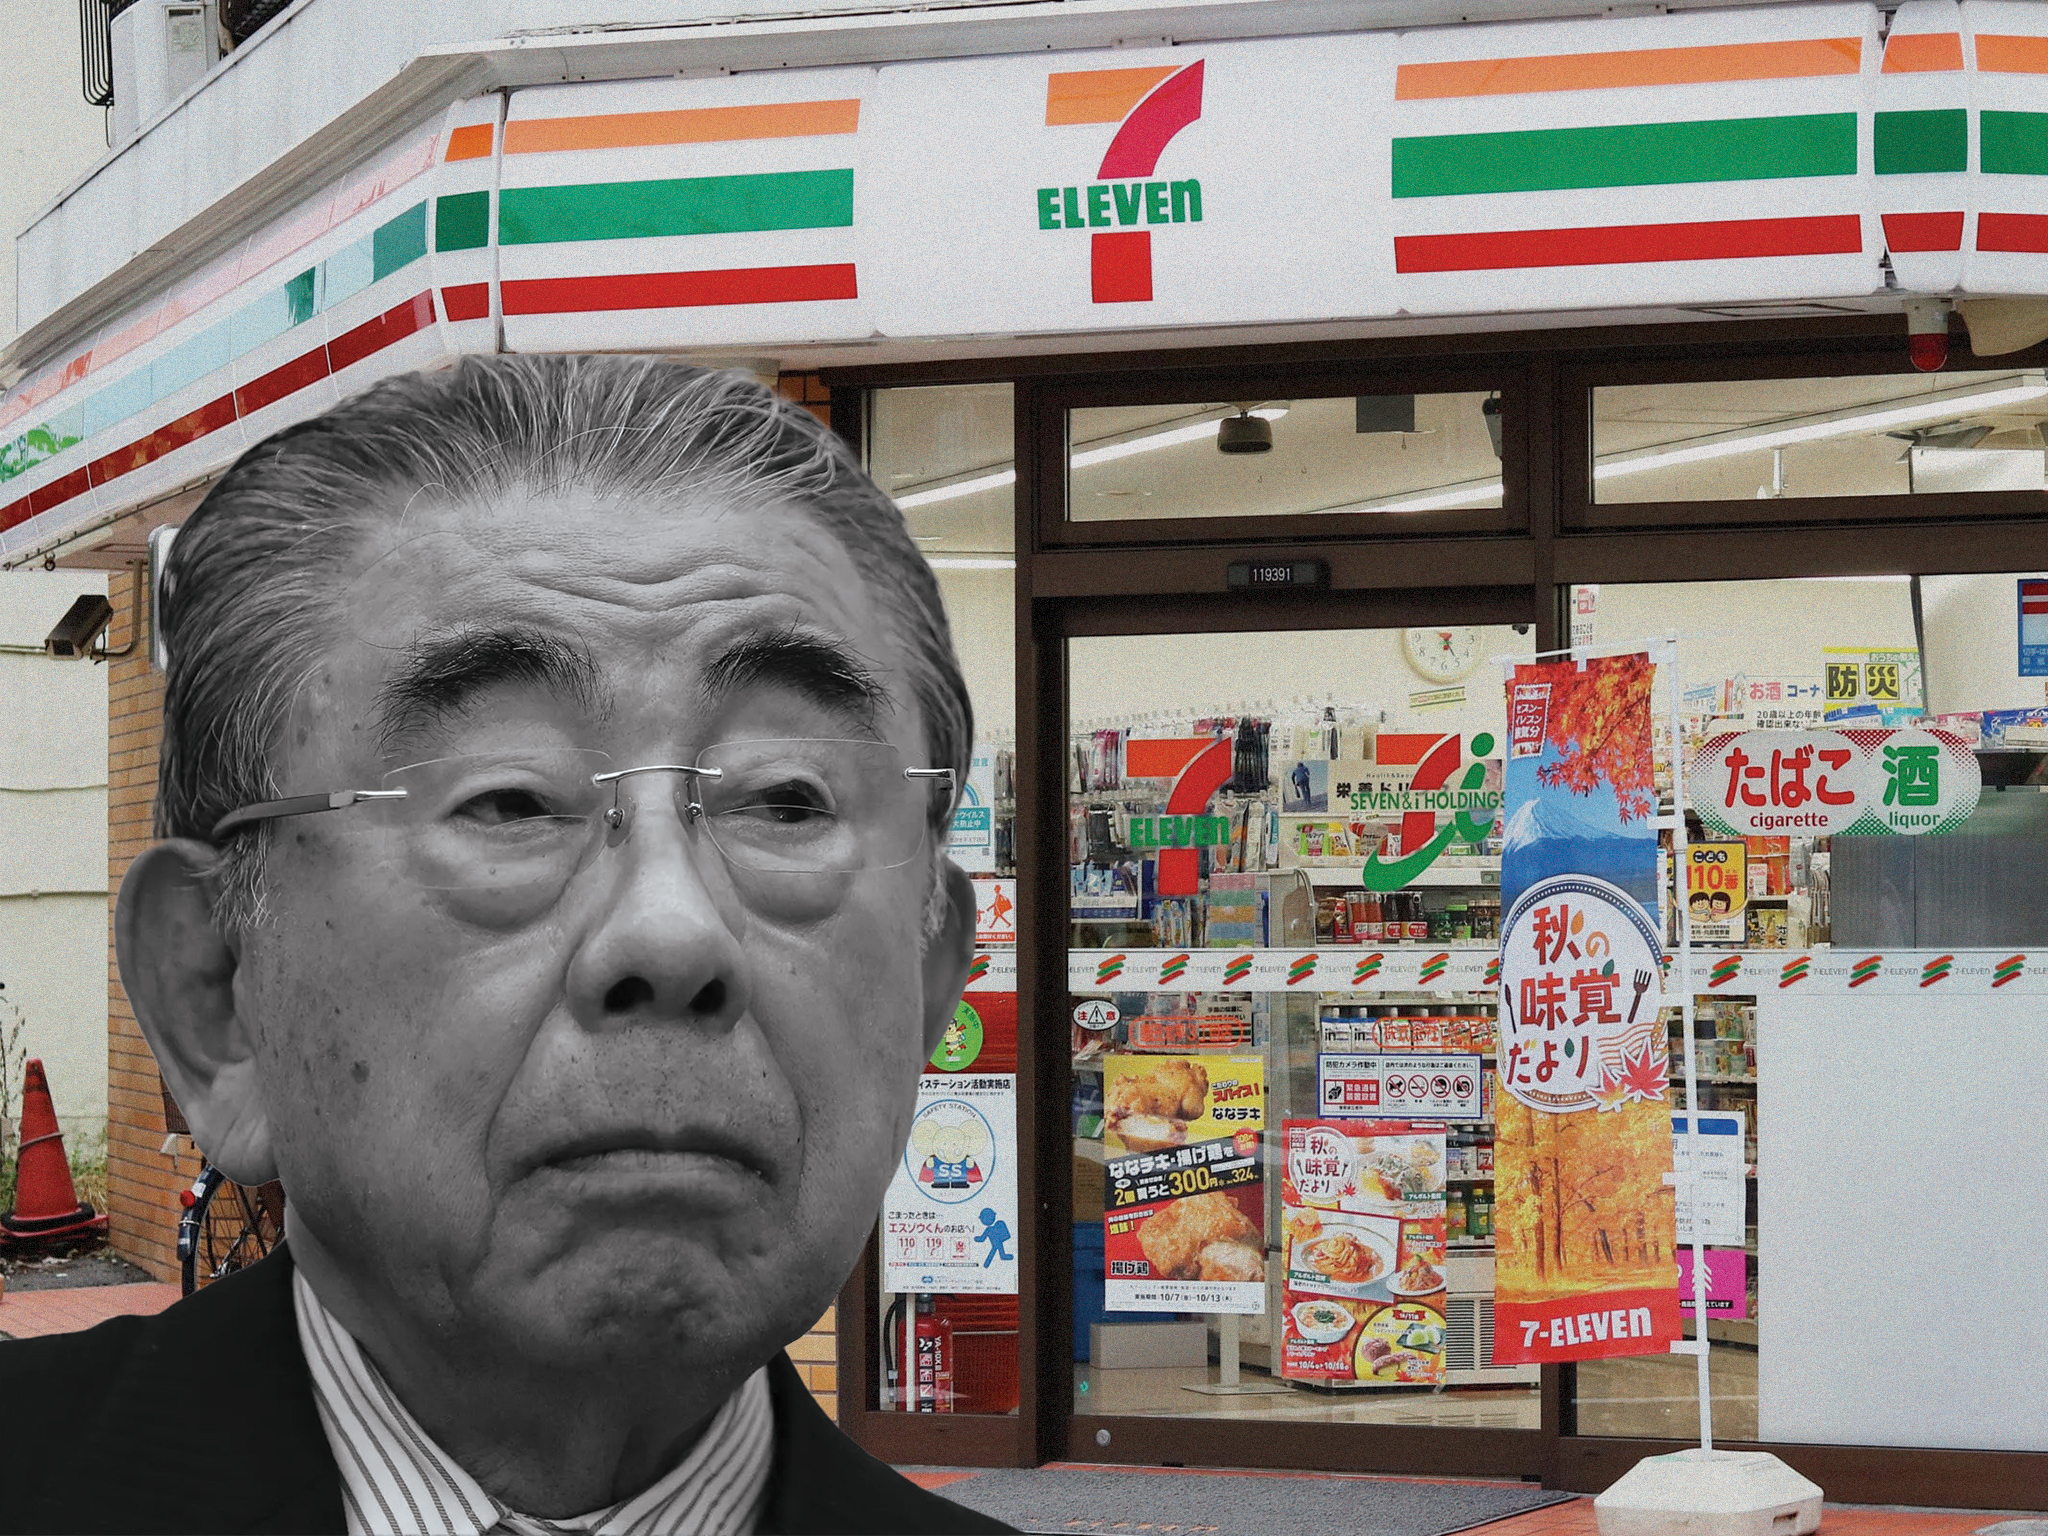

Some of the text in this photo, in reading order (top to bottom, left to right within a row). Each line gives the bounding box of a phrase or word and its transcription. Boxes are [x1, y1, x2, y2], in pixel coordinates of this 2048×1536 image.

[1253, 567, 1290, 582] 119391
[1828, 666, 1898, 697] 防災
[1750, 682, 1823, 701] お酒 コーナ
[1757, 720, 1803, 729] 確認出来な
[1725, 744, 1855, 808] たばこ
[1882, 745, 1940, 806] 酒
[1750, 812, 1828, 831] cigarette
[1889, 811, 1941, 829] liquor
[1693, 850, 1727, 863] こども
[1532, 904, 1610, 965] 秋の
[1519, 967, 1622, 1031] 味覚
[1325, 1028, 1337, 1041] in
[1354, 1028, 1366, 1041] in
[1326, 1061, 1377, 1069] 防犯カメラ作動中
[1506, 1034, 1590, 1085] だより
[922, 1103, 977, 1119] SAFETY STATION
[1310, 1136, 1337, 1155] 秋の
[940, 1164, 962, 1177] SS
[1305, 1157, 1341, 1177] 味覚
[1299, 1180, 1330, 1194] だより
[899, 1238, 942, 1248] 110 119
